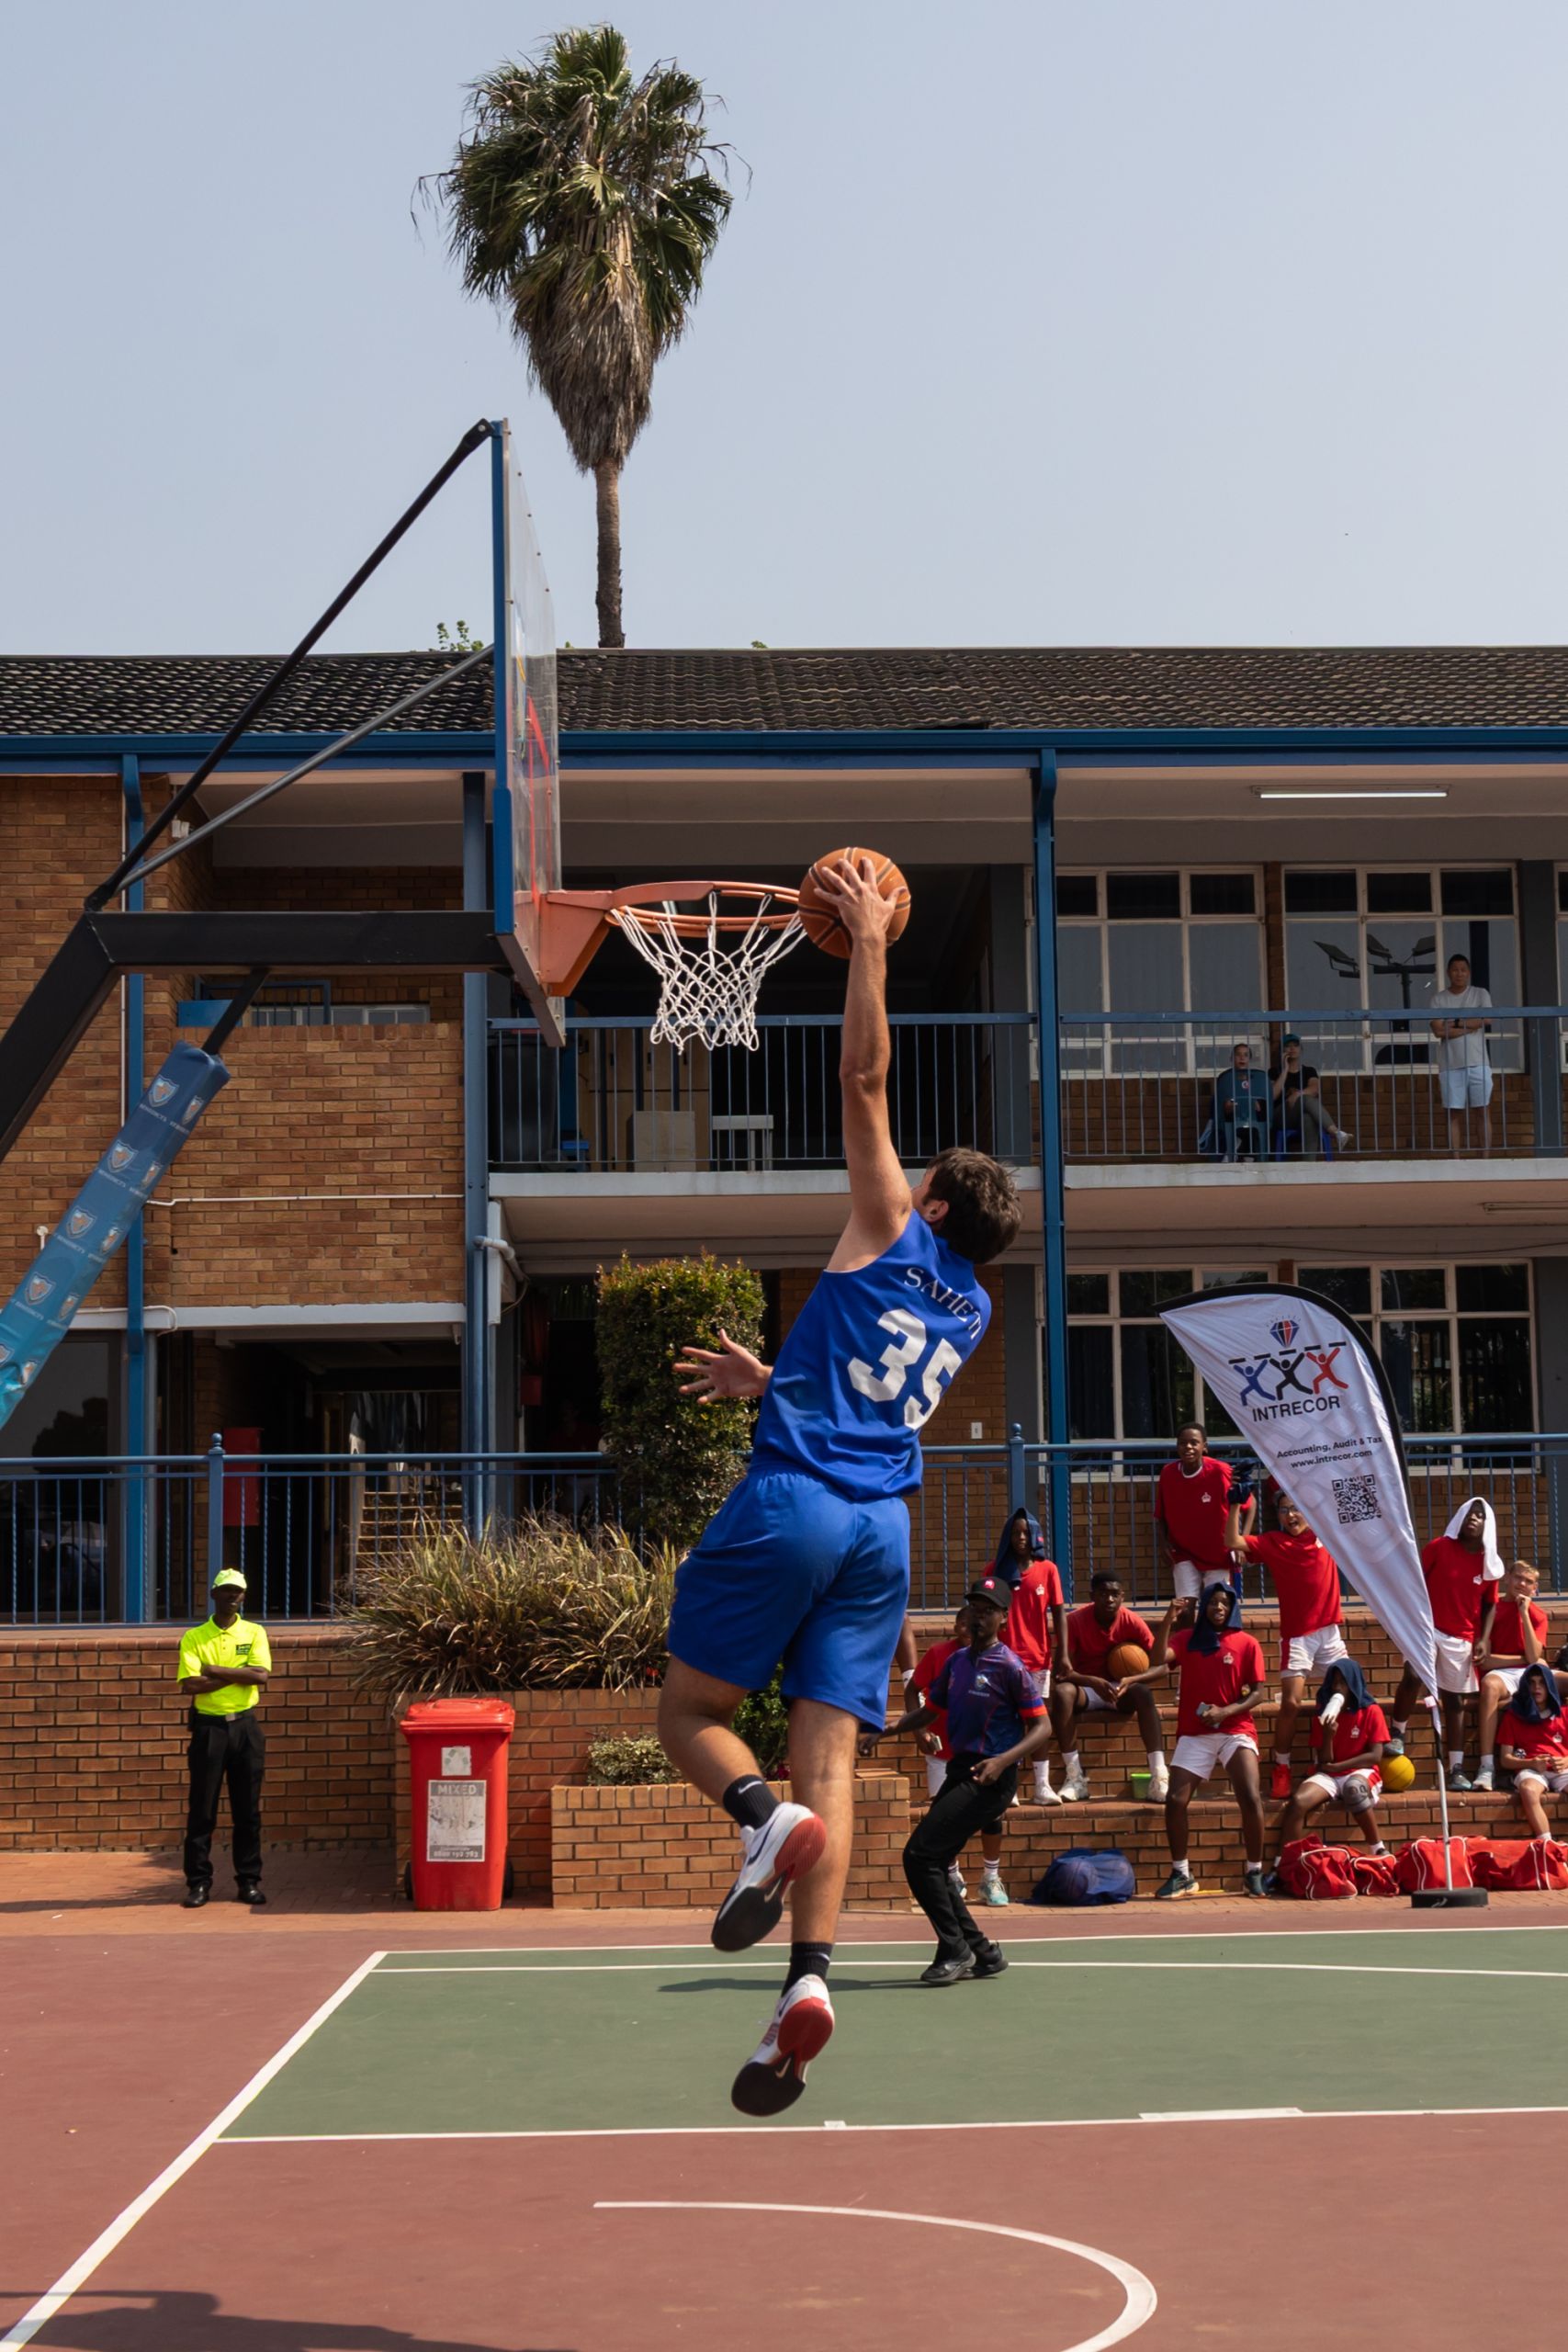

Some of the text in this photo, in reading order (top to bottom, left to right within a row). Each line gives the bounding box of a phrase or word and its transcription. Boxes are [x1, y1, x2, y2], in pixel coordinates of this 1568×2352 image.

[847, 1308, 963, 1431] 35
[1253, 1396, 1340, 1421] INTRECOR
[1277, 1443, 1331, 1458] Accounting,
[1333, 1439, 1357, 1450] Audit
[1367, 1436, 1382, 1444] Tax
[1291, 1450, 1372, 1468] www.intrecor.com
[437, 1784, 477, 1794] MIXED
